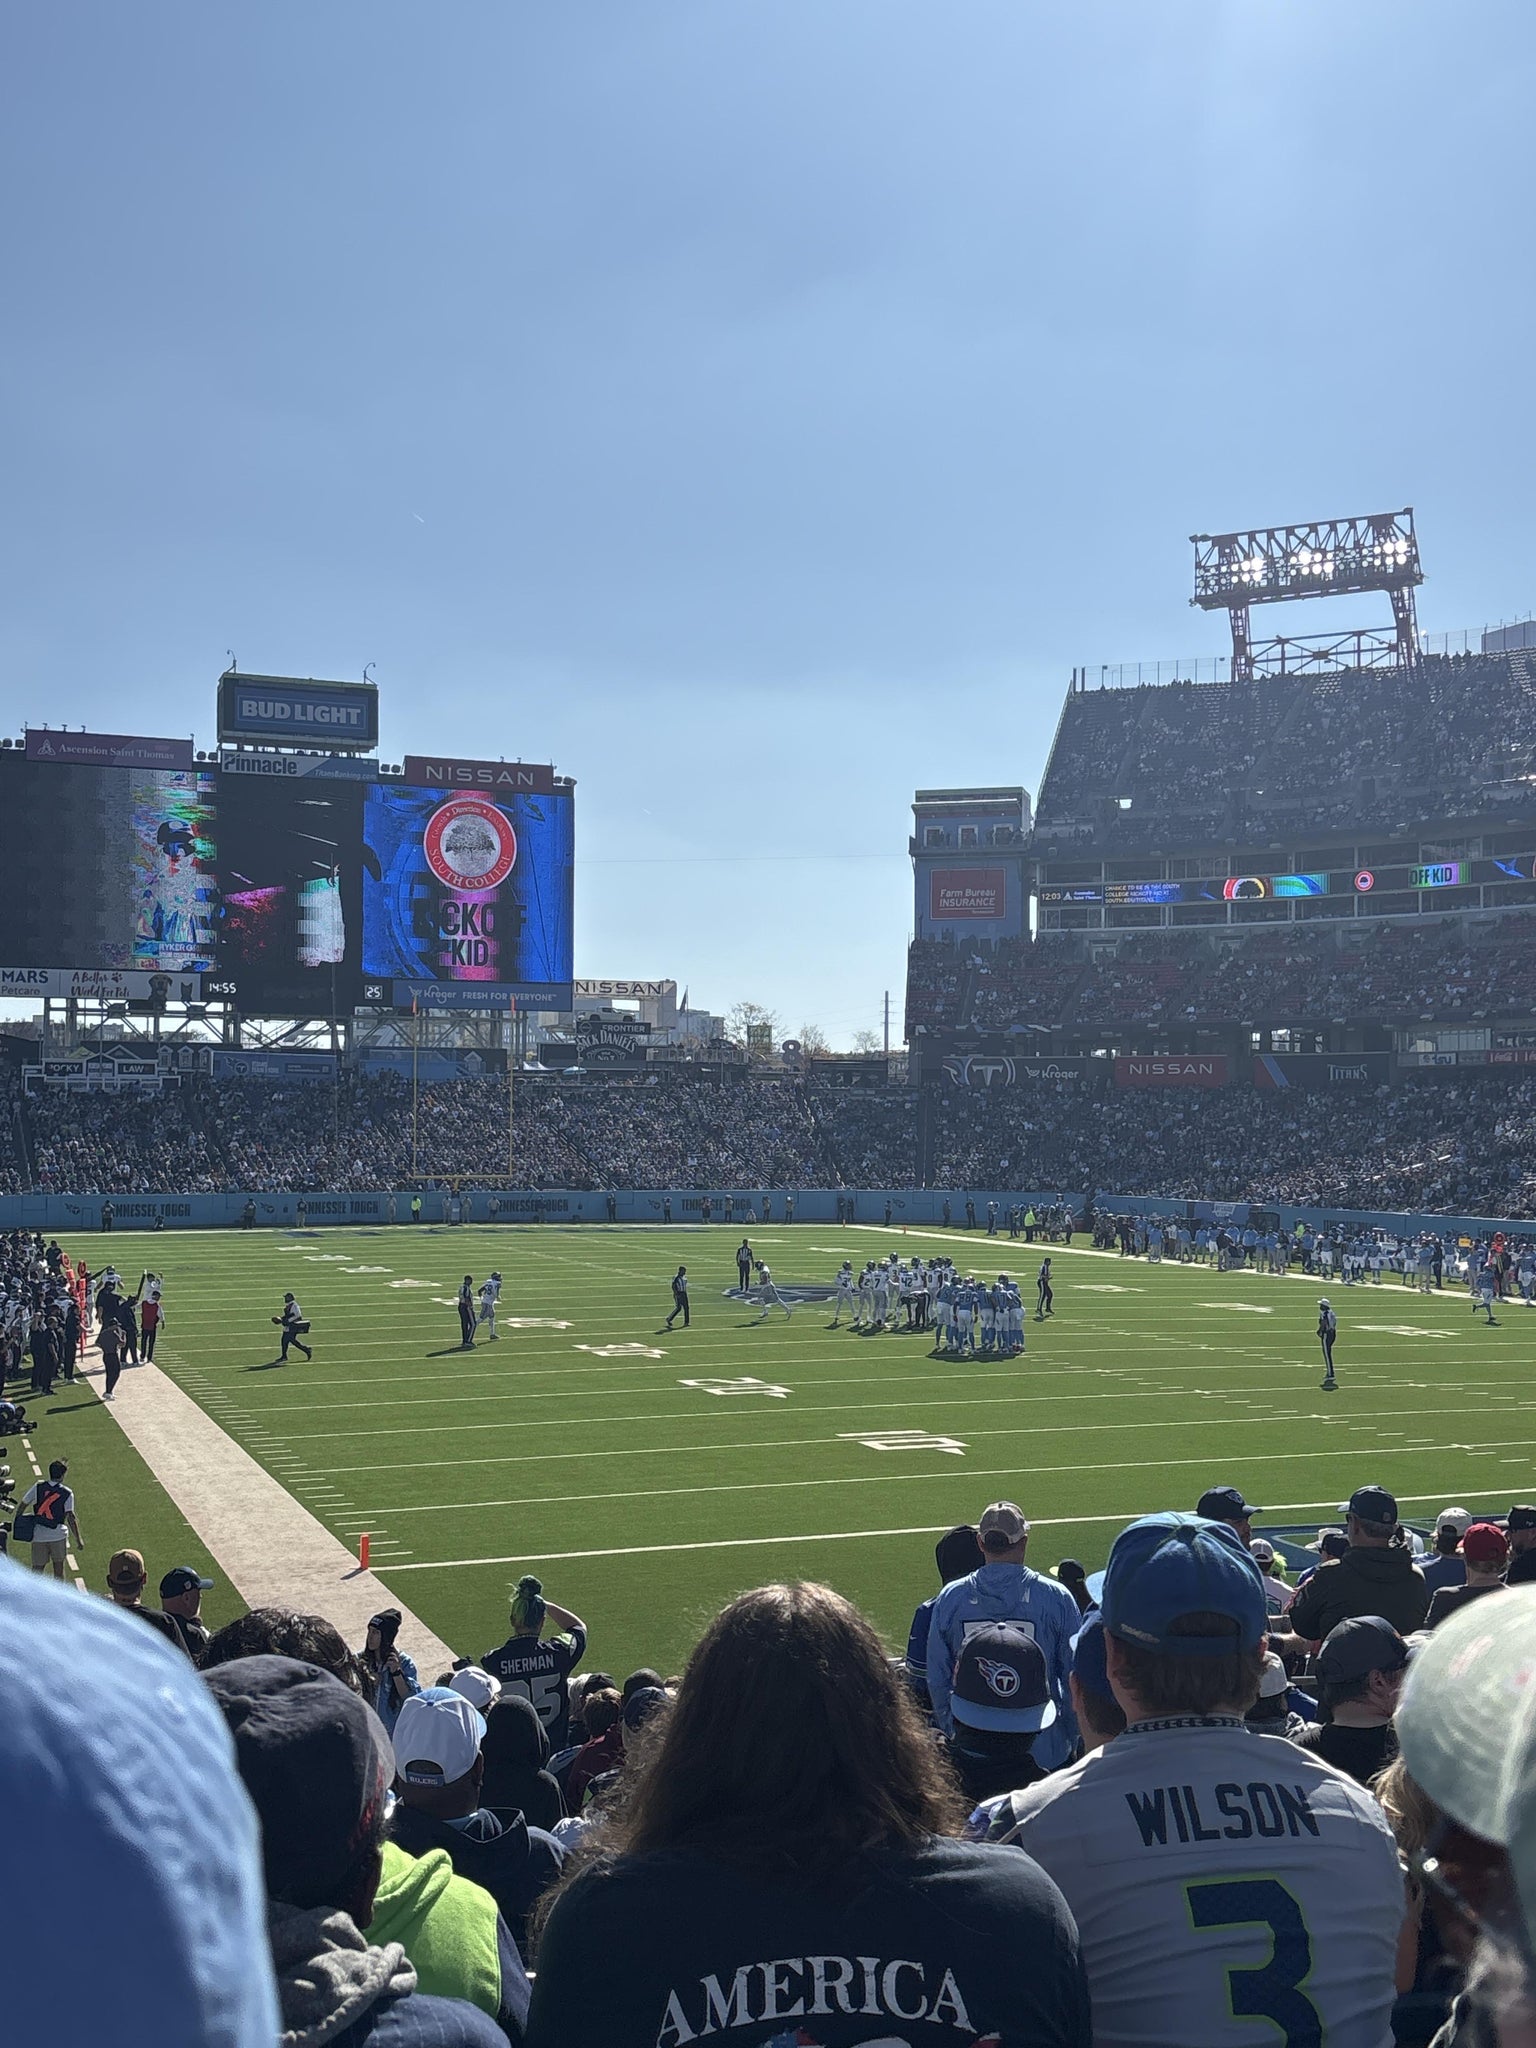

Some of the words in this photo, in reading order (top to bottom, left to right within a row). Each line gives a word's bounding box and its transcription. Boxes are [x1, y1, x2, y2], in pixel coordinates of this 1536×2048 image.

[242, 701, 291, 719] BUD
[294, 704, 361, 725] LIGHT
[59, 744, 108, 755] Ascension
[110, 748, 134, 757] Saint
[136, 749, 175, 759] Thomas
[224, 754, 297, 774] Pinnacle
[426, 765, 534, 786] NISSAN
[1433, 867, 1452, 883] KID
[940, 889, 963, 898] Farm
[965, 888, 996, 898] Bureau
[1041, 892, 1062, 900] 12:03
[939, 897, 996, 908] INSURANCE
[451, 939, 489, 967] KID
[1, 970, 49, 984] MARS
[72, 971, 80, 983] A
[1, 985, 41, 996] Petcare
[208, 982, 237, 994] 14:55
[366, 986, 381, 997] 25
[424, 985, 457, 1004] Kroger
[463, 991, 487, 1000] FRESH
[490, 992, 507, 1001] FOR
[575, 981, 661, 995] NISSAN
[602, 1024, 646, 1033] FRONTIER
[123, 1064, 145, 1073] LAW
[1042, 1064, 1079, 1080] Kroger
[1129, 1063, 1213, 1075] NISSAN
[1327, 1063, 1368, 1081] TITANS
[874, 1278, 881, 1289] 7
[901, 1277, 913, 1288] 42
[677, 1376, 795, 1398] 20
[835, 1429, 971, 1455] 10
[500, 1654, 554, 1675] SHERMAN
[1125, 1782, 1320, 1848] WILSON
[655, 1955, 978, 2048] AMERICA
